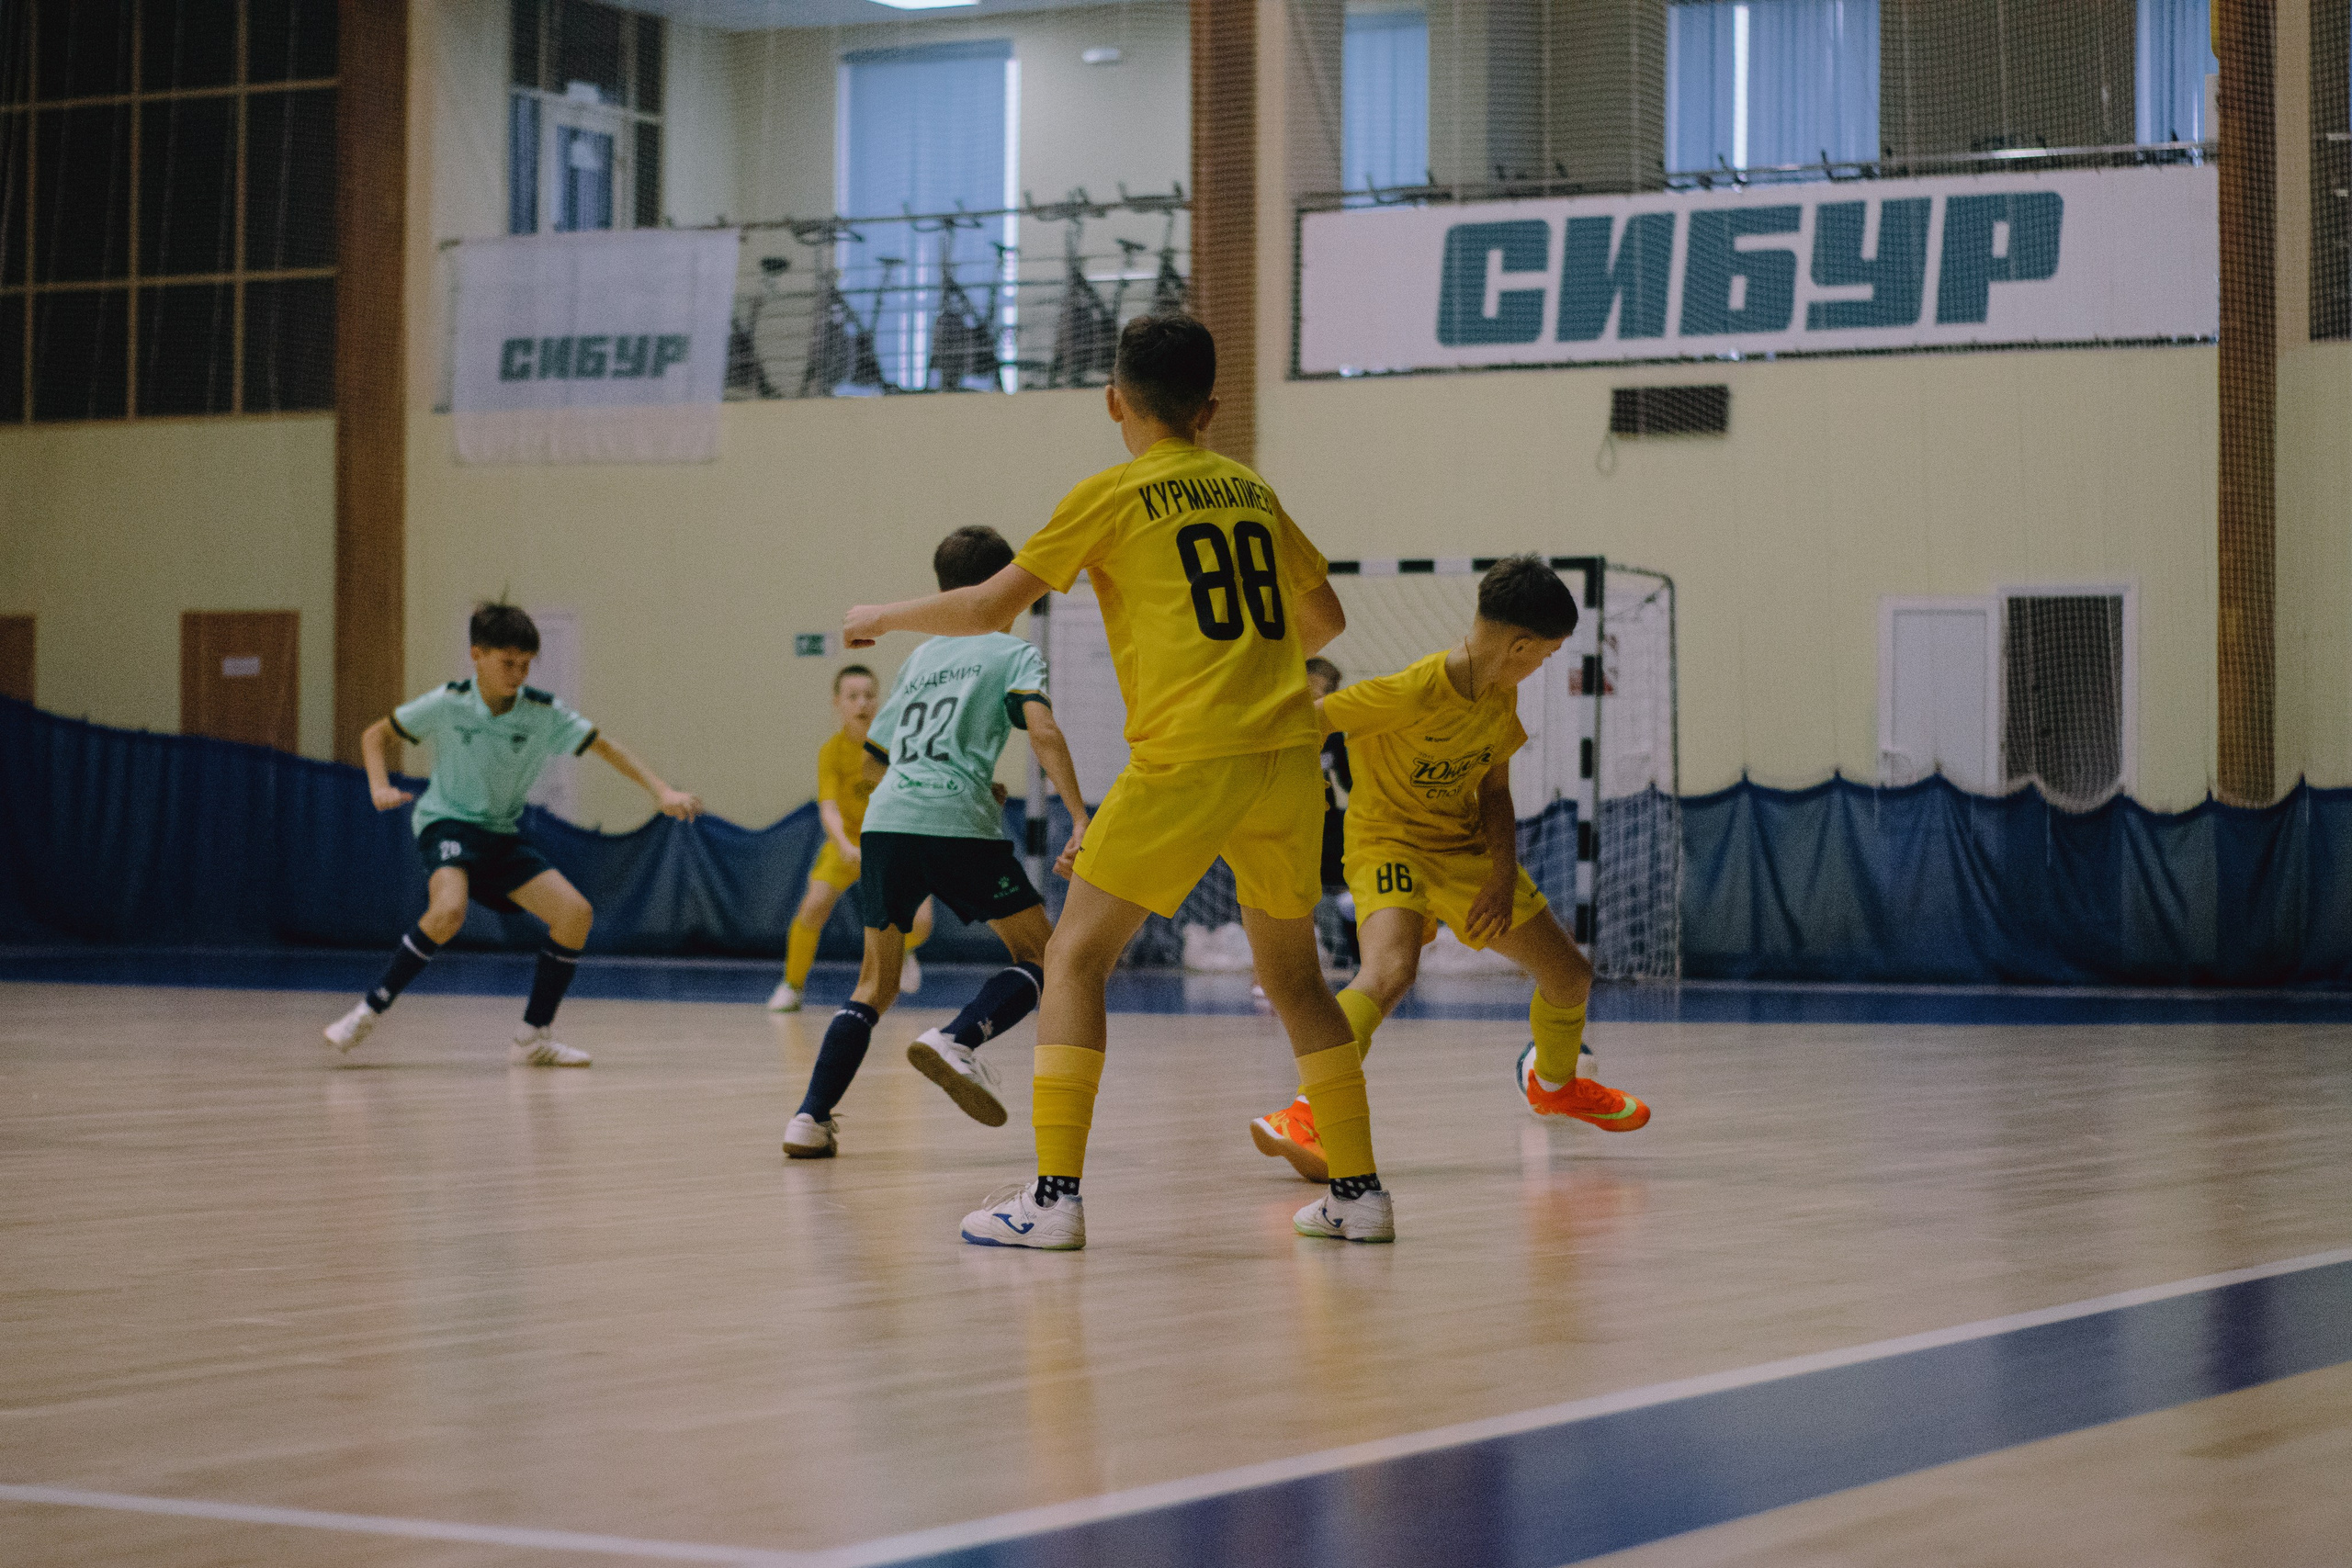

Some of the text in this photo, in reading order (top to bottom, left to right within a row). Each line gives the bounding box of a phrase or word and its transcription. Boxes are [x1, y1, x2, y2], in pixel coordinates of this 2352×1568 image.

[1435, 192, 2064, 347] СИБУР
[499, 334, 690, 382] СИБУР
[1176, 521, 1285, 641] 88
[904, 664, 982, 695] АКАДЕМИЯ
[898, 696, 959, 765] 22
[1376, 862, 1413, 895] 86
